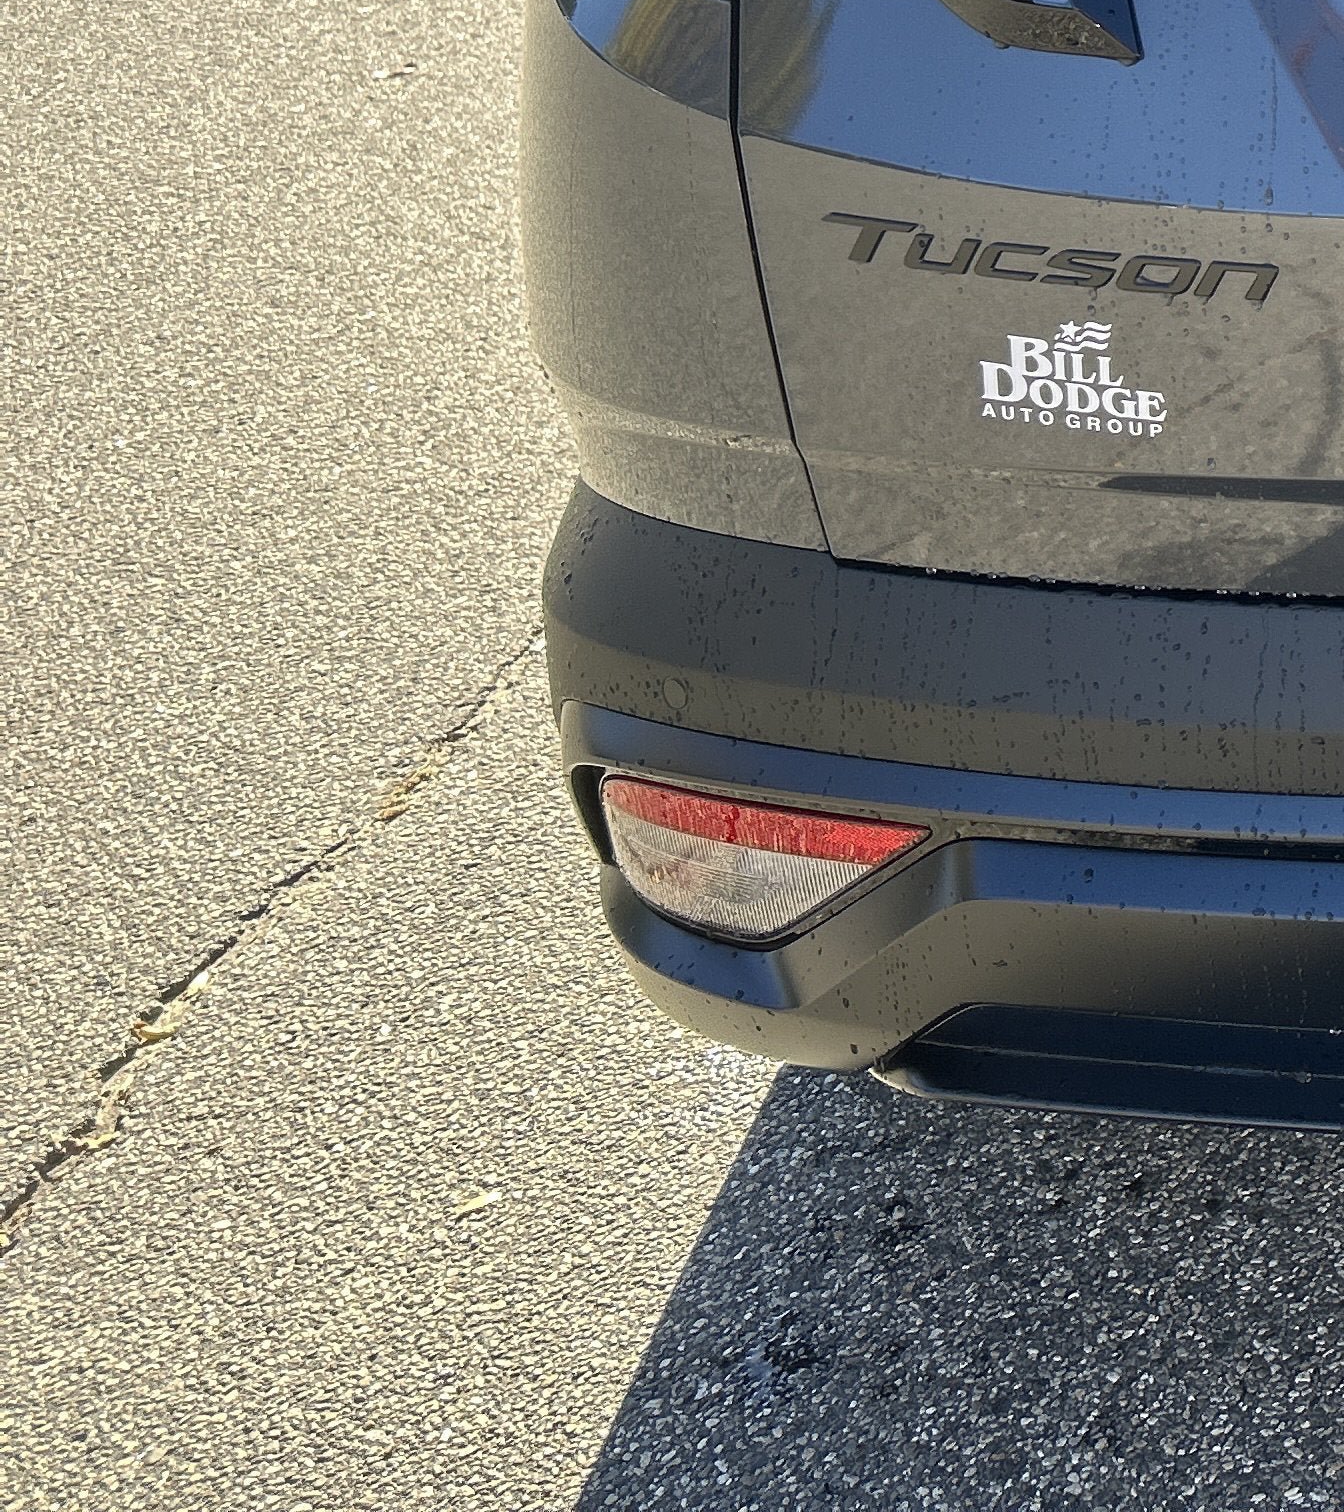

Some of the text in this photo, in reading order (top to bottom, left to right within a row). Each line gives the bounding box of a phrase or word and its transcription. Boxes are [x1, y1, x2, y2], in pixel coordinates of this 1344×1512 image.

[1006, 334, 1124, 387] BILL
[979, 360, 1168, 422] DODGE
[981, 402, 1163, 438] AUTO GROUP
